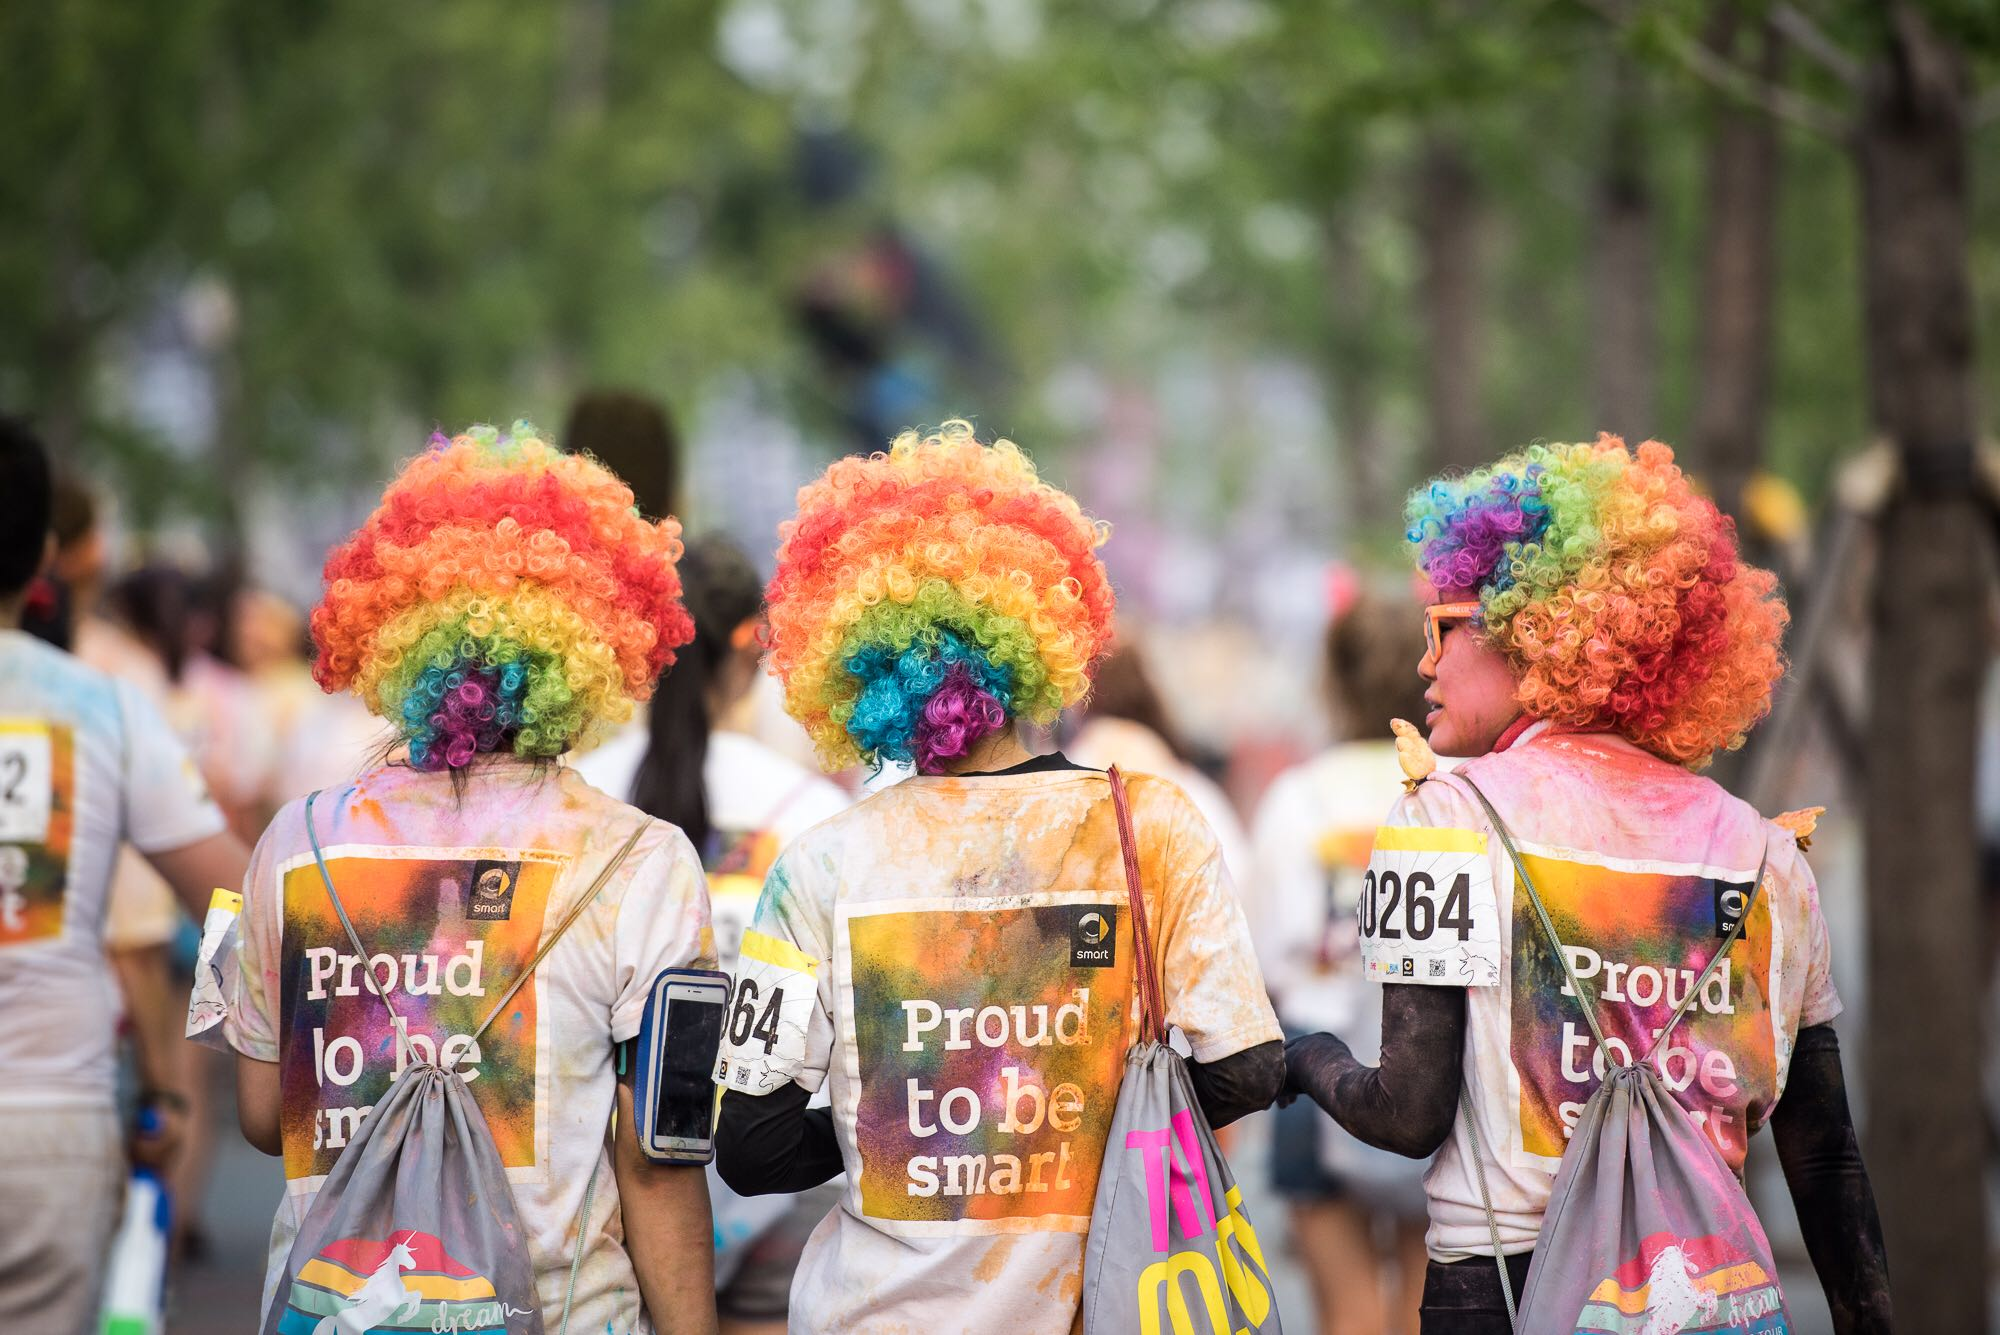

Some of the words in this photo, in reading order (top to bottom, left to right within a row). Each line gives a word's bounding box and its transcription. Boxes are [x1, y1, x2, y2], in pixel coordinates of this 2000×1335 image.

[473, 903, 506, 914] smart
[305, 940, 485, 1000] Proud
[1076, 949, 1109, 959] smart
[1561, 945, 1735, 1014] Proud
[901, 988, 1092, 1051] Proud
[1651, 1029, 1738, 1097] be
[907, 1078, 981, 1138] to
[998, 1067, 1085, 1134] be
[907, 1142, 1075, 1197] smart
[432, 1301, 534, 1335] dream
